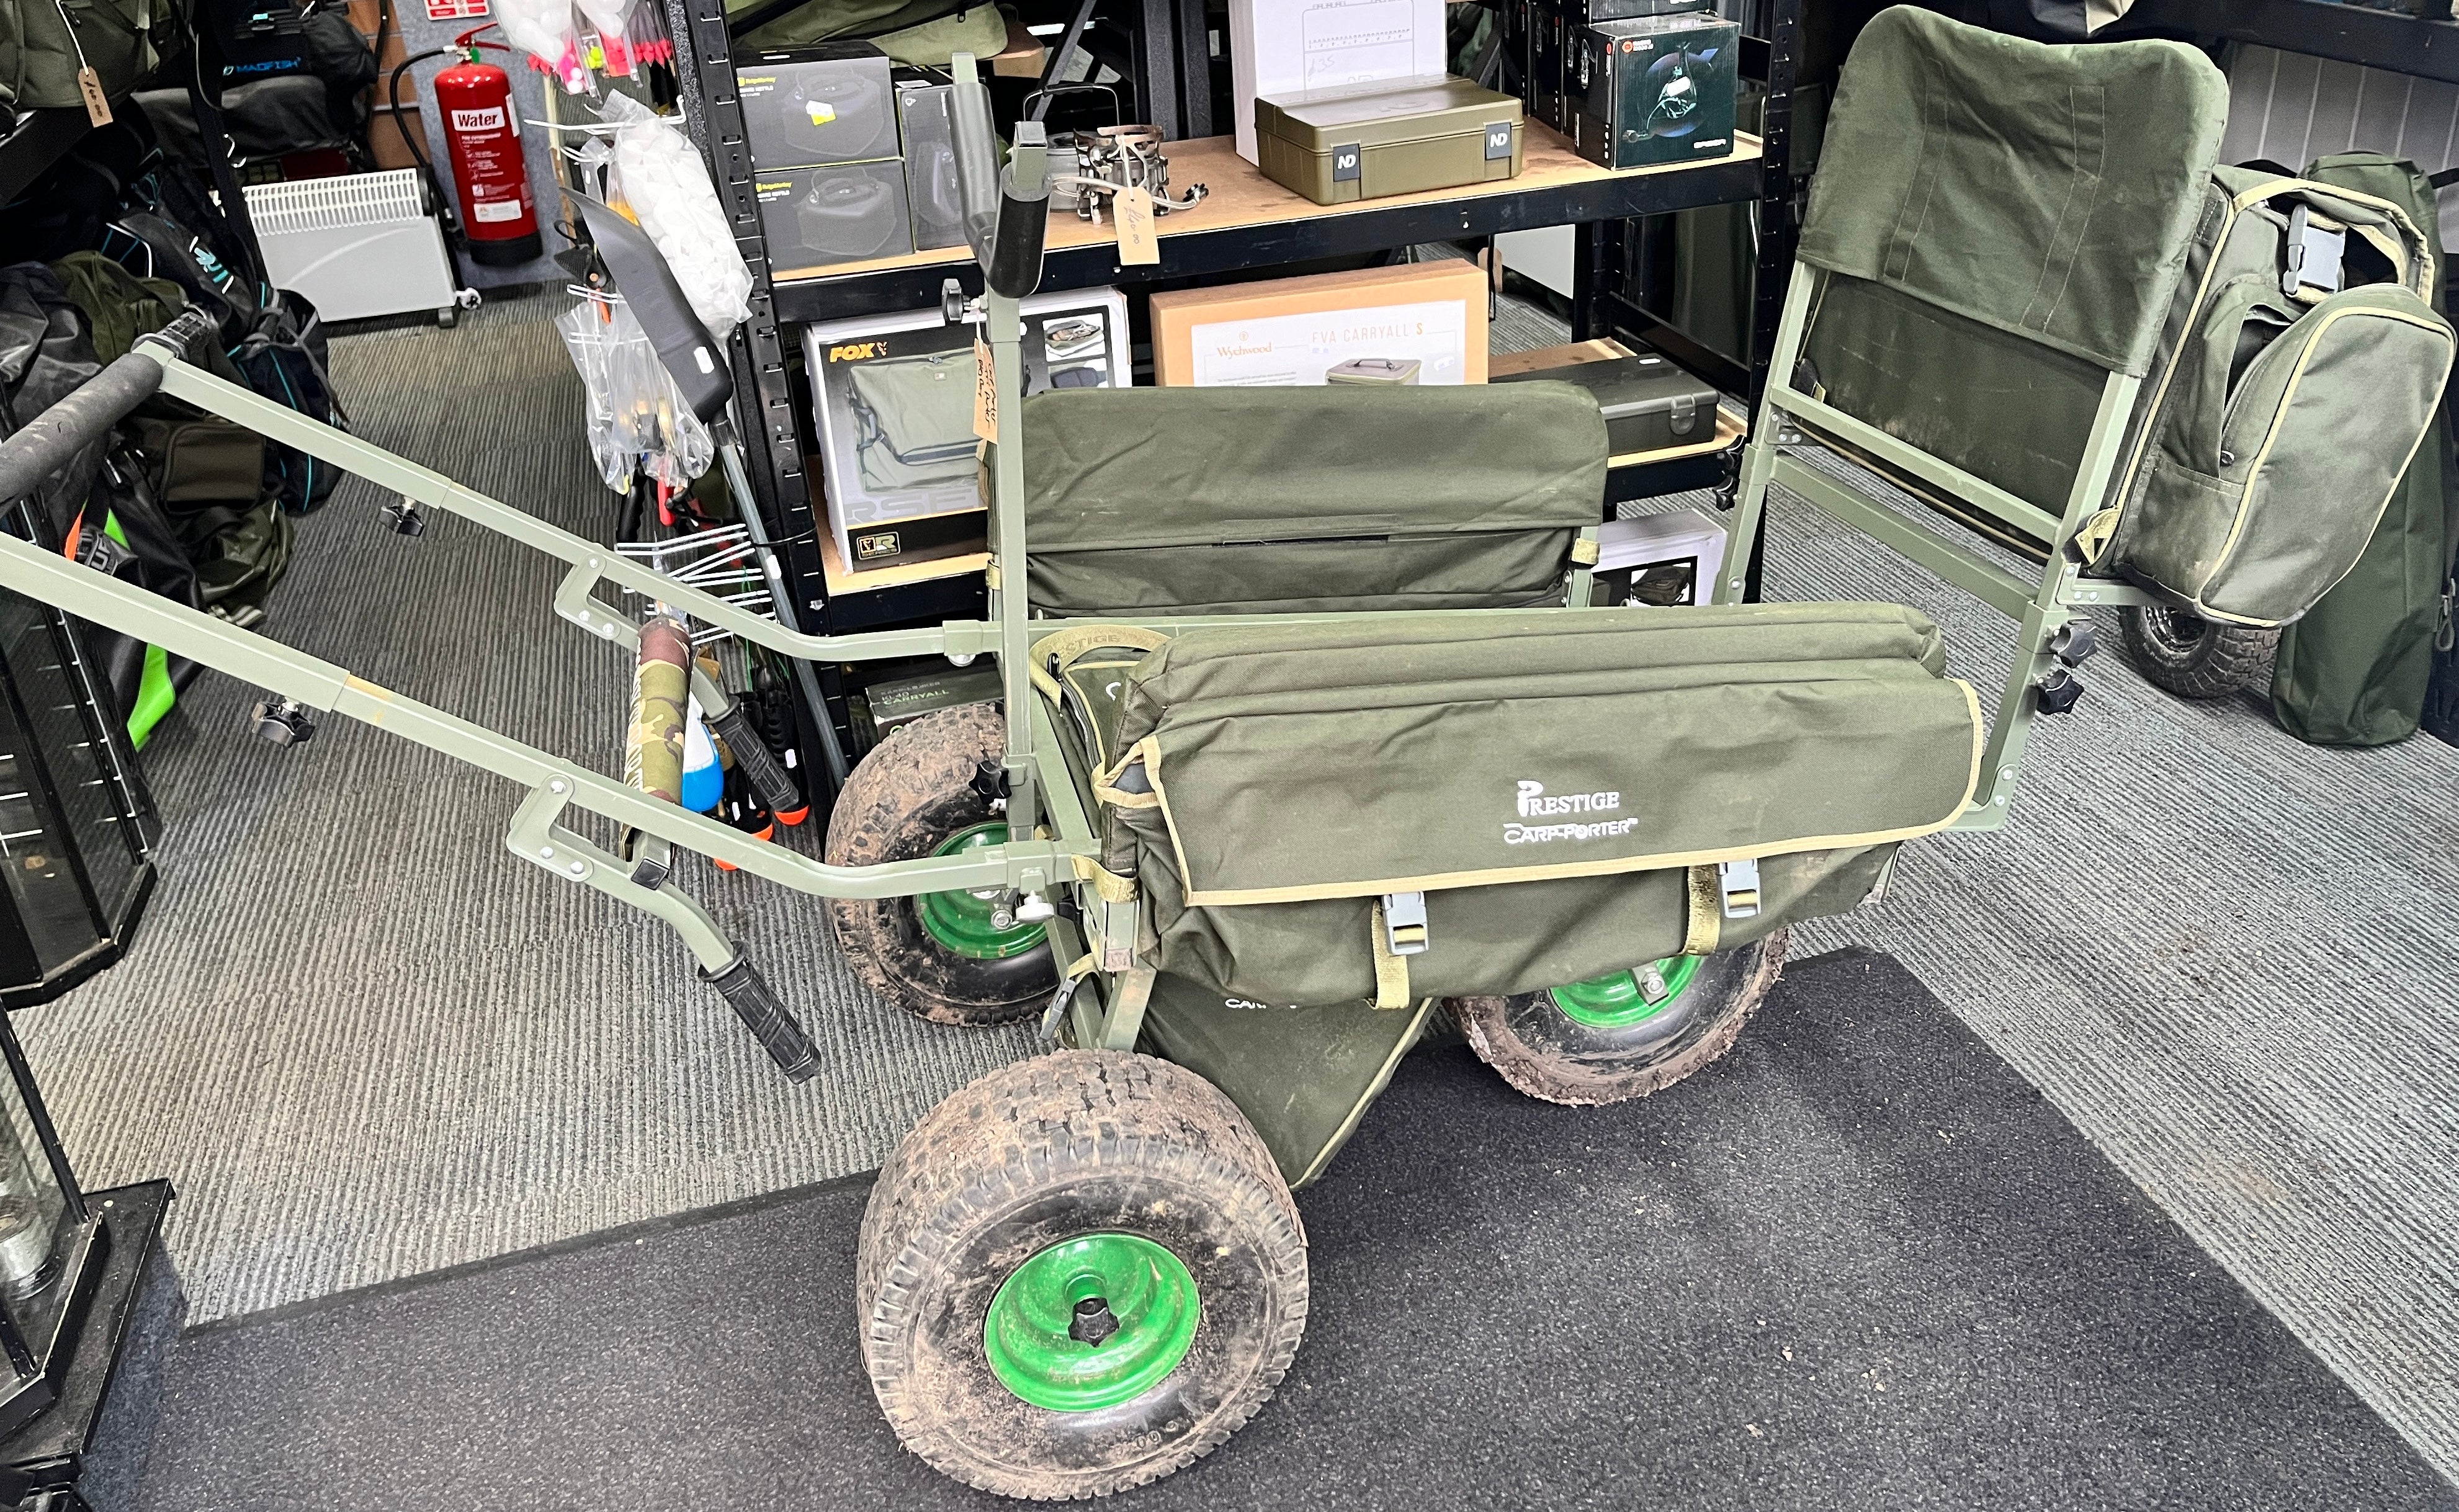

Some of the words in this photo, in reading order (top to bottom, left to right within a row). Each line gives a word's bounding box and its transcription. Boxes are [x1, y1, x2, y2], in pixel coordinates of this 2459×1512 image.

[457, 113, 498, 128] Water
[1312, 331, 1337, 343] EVA
[1343, 323, 1409, 342] CARRYALL
[1416, 322, 1423, 335] S
[830, 342, 876, 363] FOX
[1216, 342, 1273, 359] Wychwood
[883, 689, 950, 705] CARRYALL
